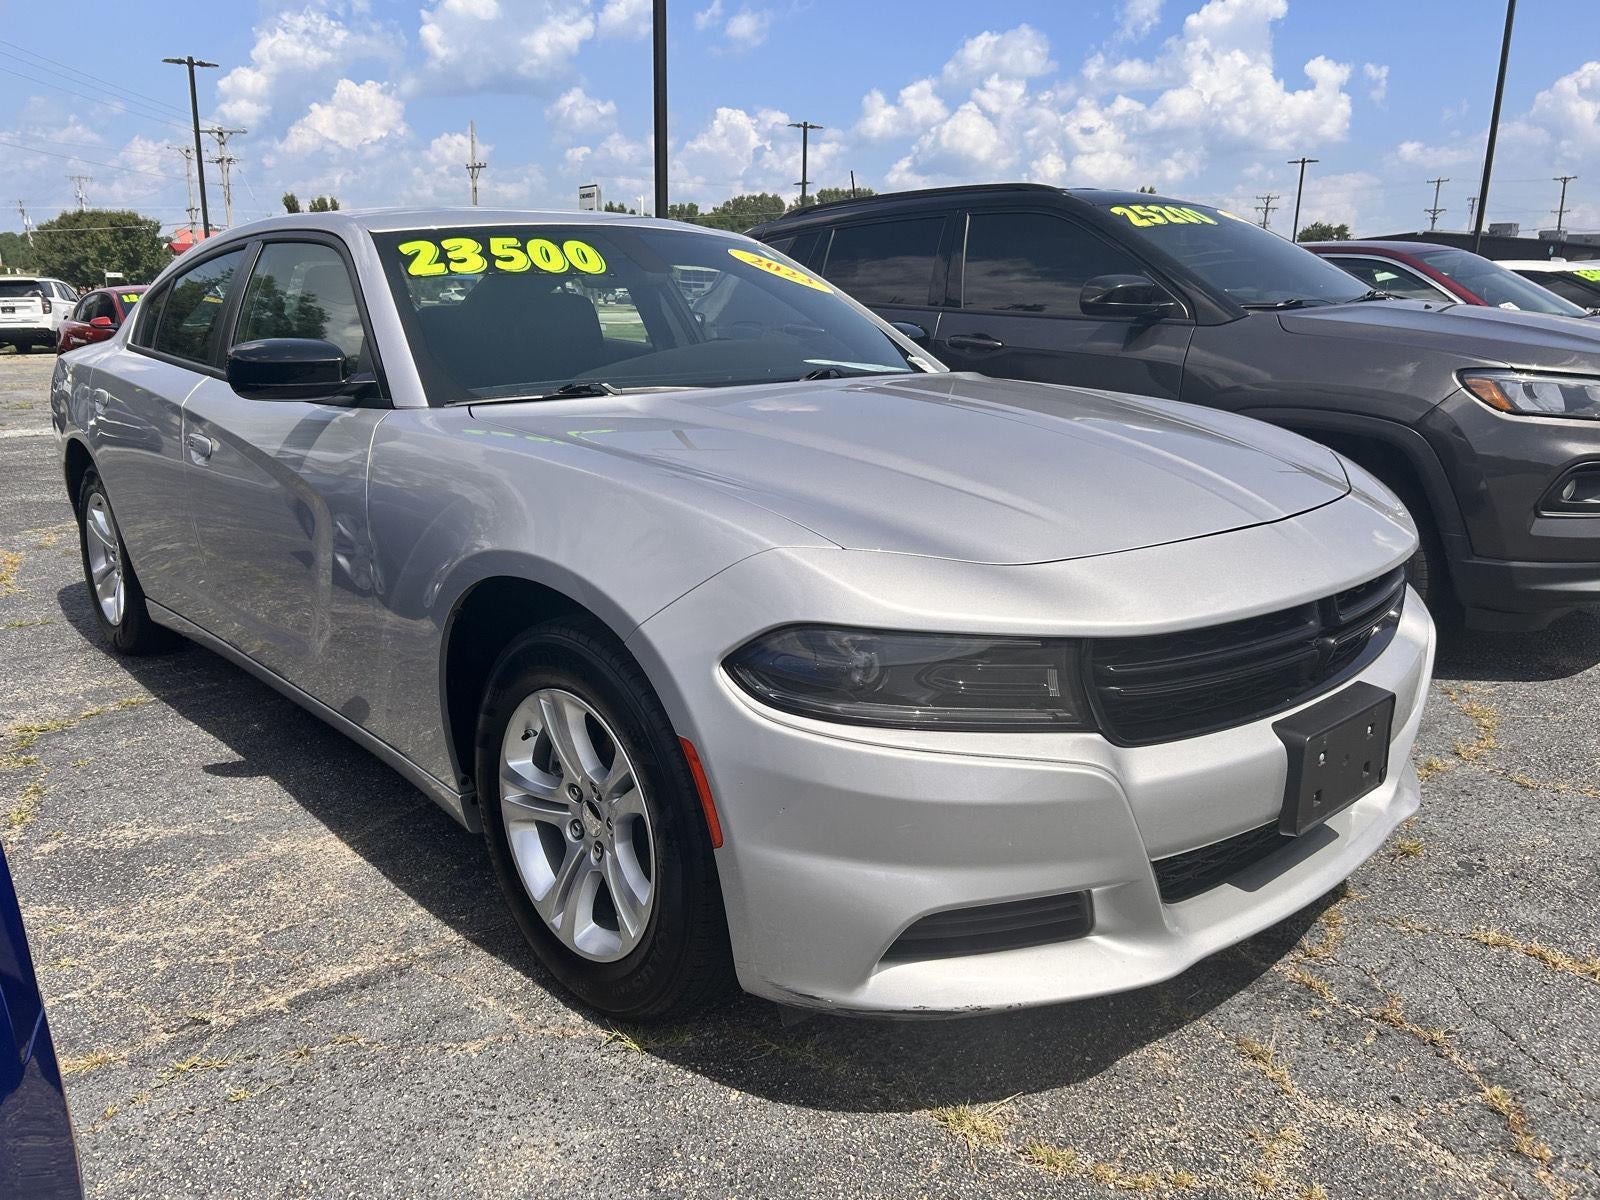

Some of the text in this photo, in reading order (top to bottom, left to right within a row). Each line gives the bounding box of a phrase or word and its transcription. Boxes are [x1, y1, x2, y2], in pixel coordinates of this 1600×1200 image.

[1110, 205, 1219, 227] 25200
[398, 237, 607, 276] 23500
[752, 258, 814, 284] 2023
